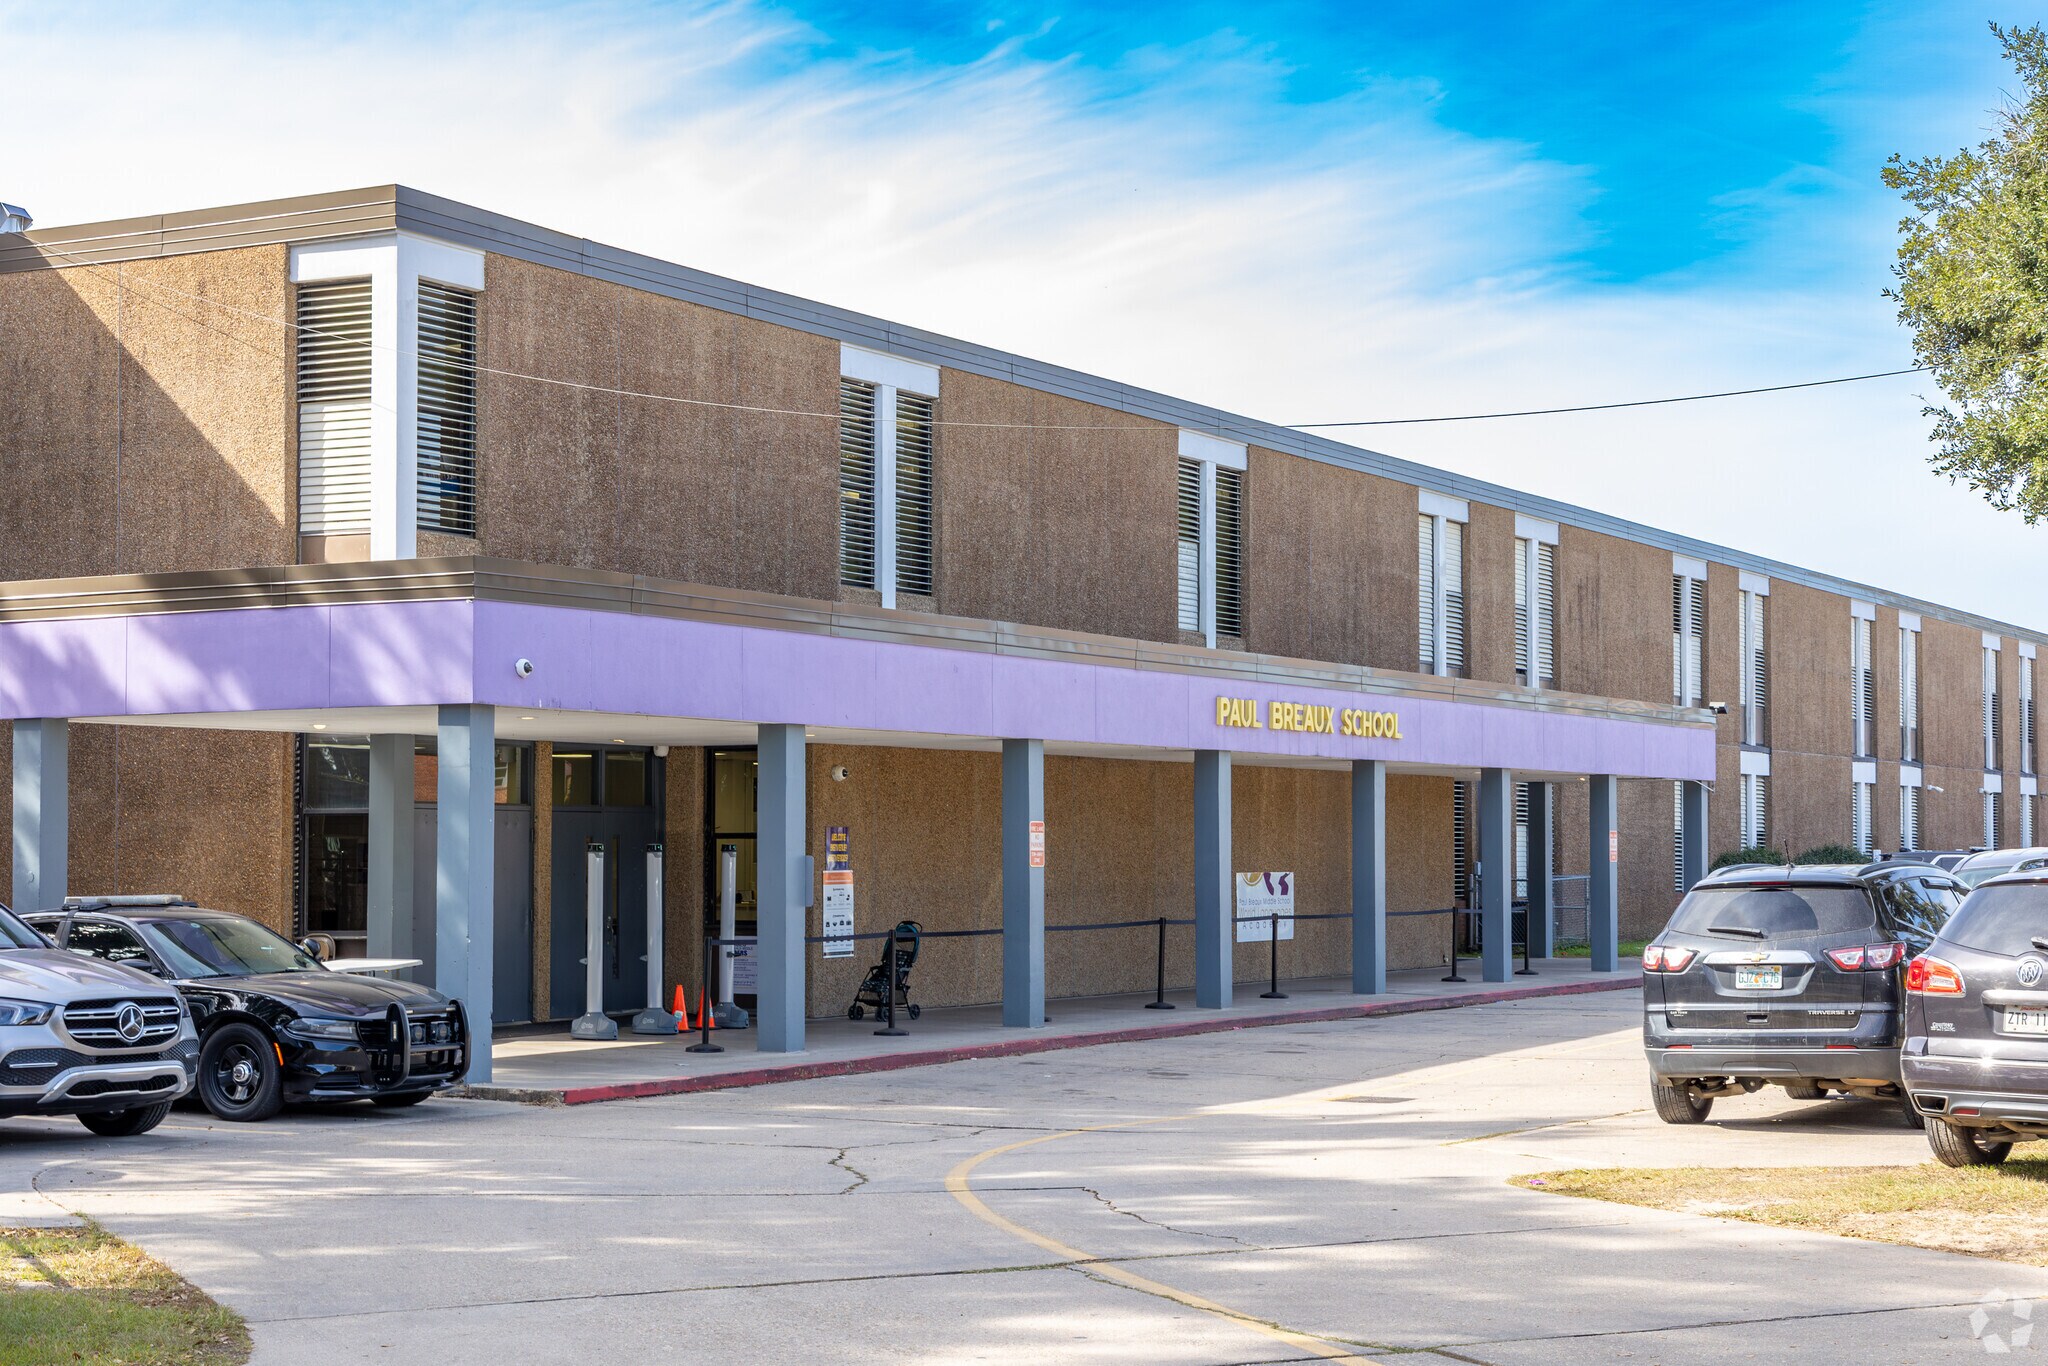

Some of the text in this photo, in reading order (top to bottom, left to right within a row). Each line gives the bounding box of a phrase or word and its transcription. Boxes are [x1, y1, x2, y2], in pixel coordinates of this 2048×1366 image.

[1216, 696, 1403, 739] PAUL BREAUX SCHOOL
[1738, 971, 1754, 984] GJZ
[2007, 1011, 2028, 1026] ZTR
